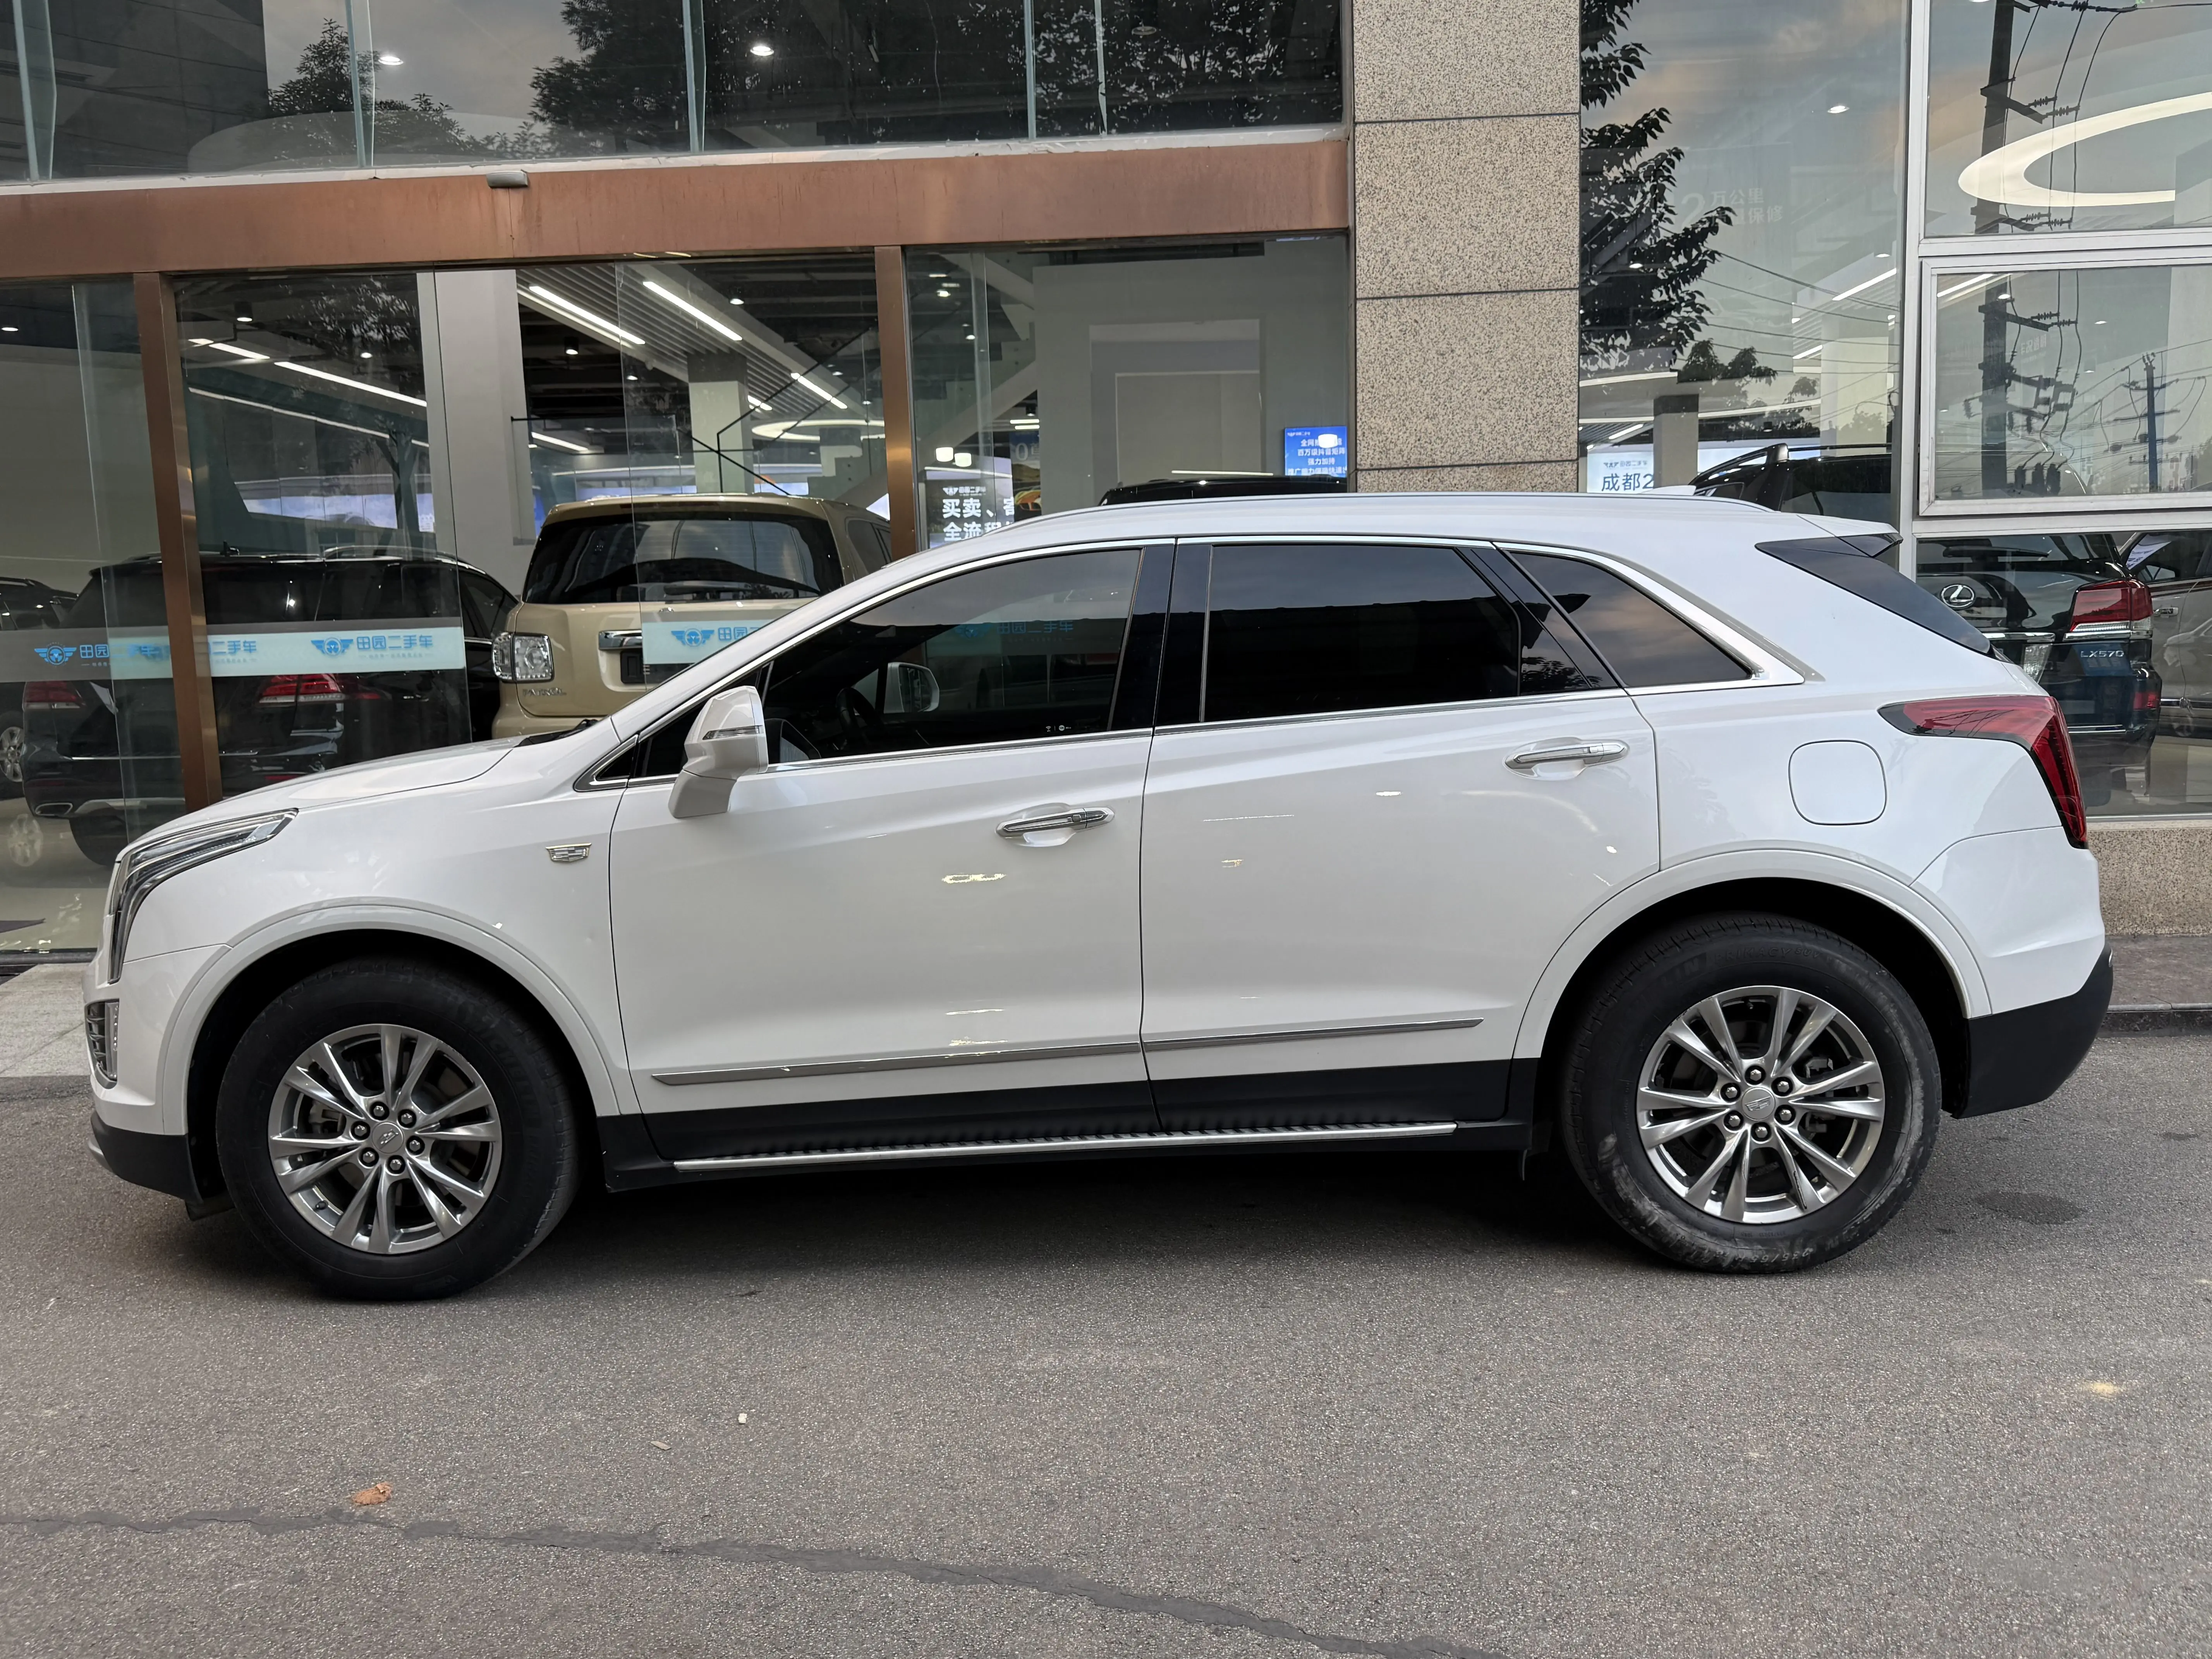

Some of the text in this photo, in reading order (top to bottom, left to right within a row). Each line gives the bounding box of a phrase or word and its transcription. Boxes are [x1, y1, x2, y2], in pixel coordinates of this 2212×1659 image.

[1711, 188, 1764, 206] 万公里
[1601, 472, 1653, 492] 成都2
[210, 639, 257, 655] 二手车
[357, 634, 433, 650] 田园二手车
[2081, 650, 2124, 658] LX570
[1715, 946, 1822, 962] PRIMACY SUV
